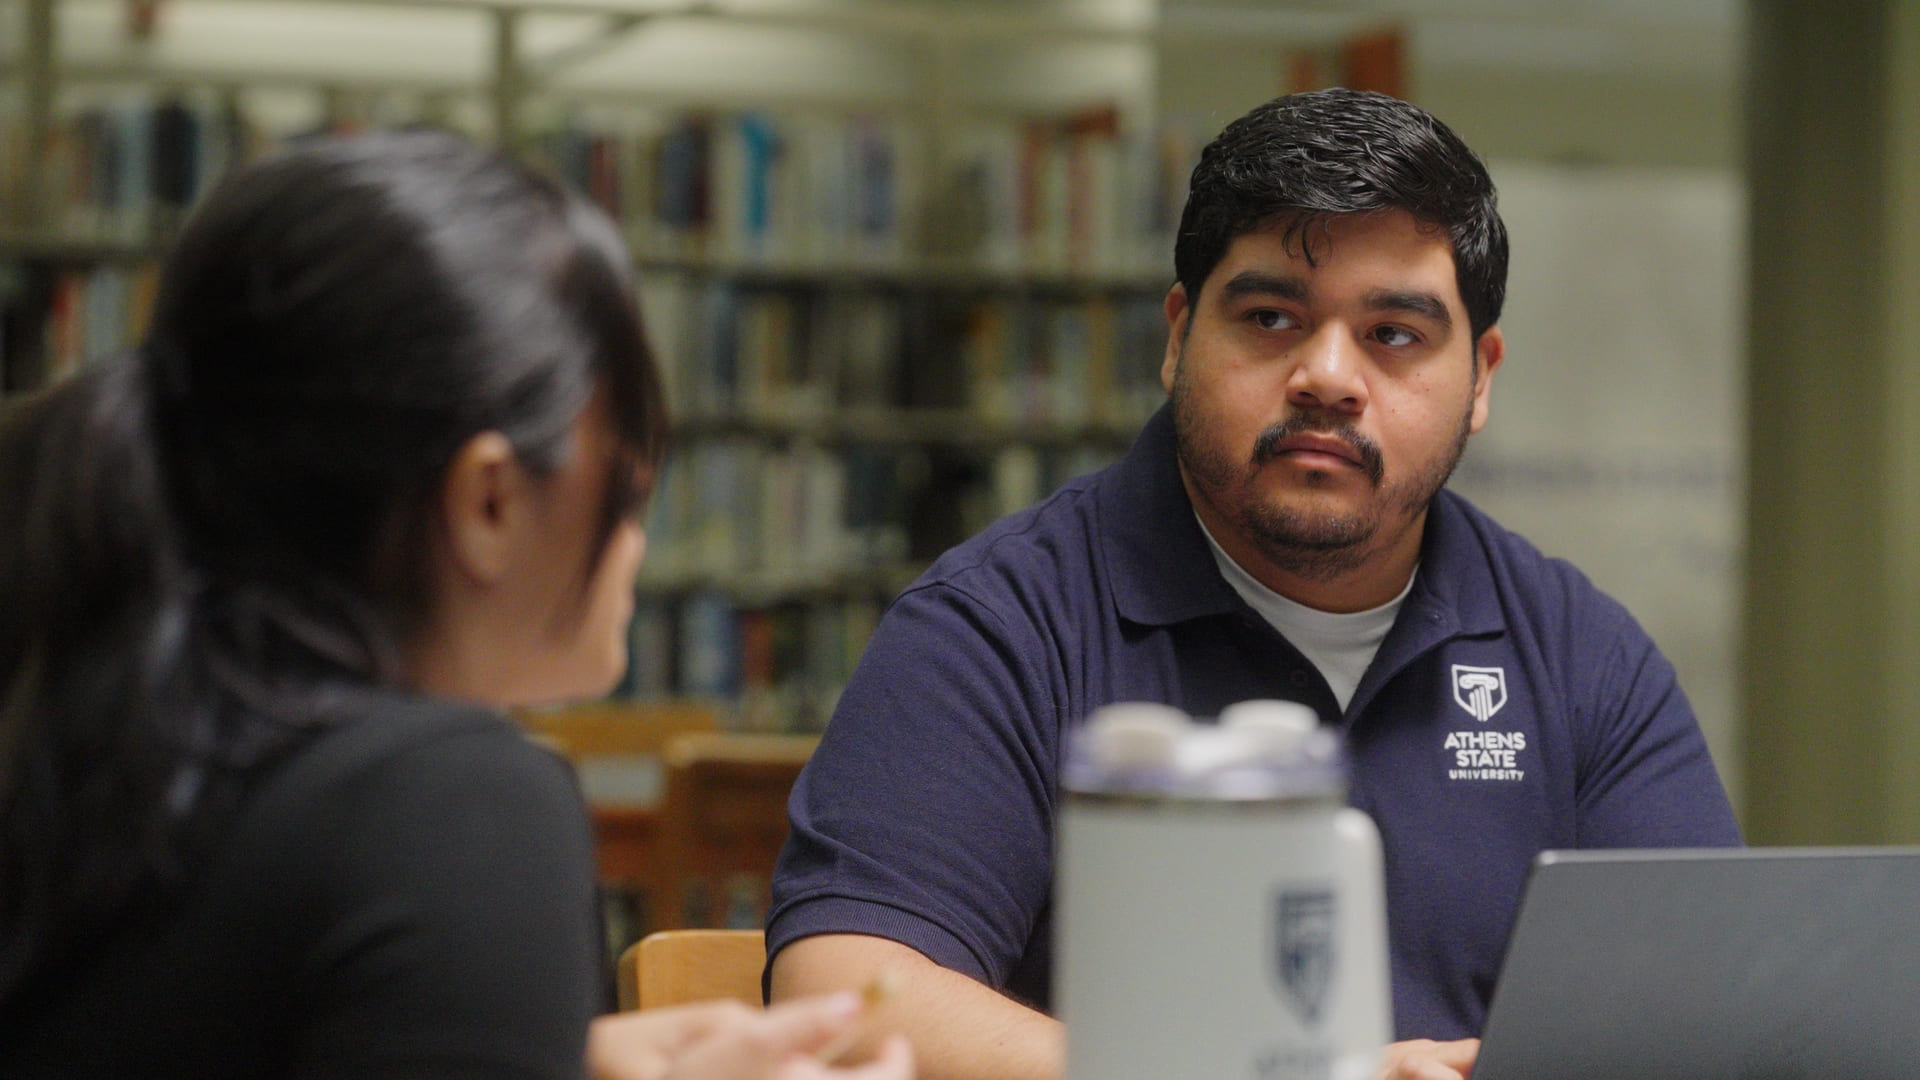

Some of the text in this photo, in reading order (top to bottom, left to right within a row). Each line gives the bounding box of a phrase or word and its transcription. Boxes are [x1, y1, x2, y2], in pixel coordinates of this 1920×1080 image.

[1444, 731, 1526, 750] ATHENS
[1456, 749, 1517, 767] STATE
[1448, 768, 1524, 781] UNIVERSITY
